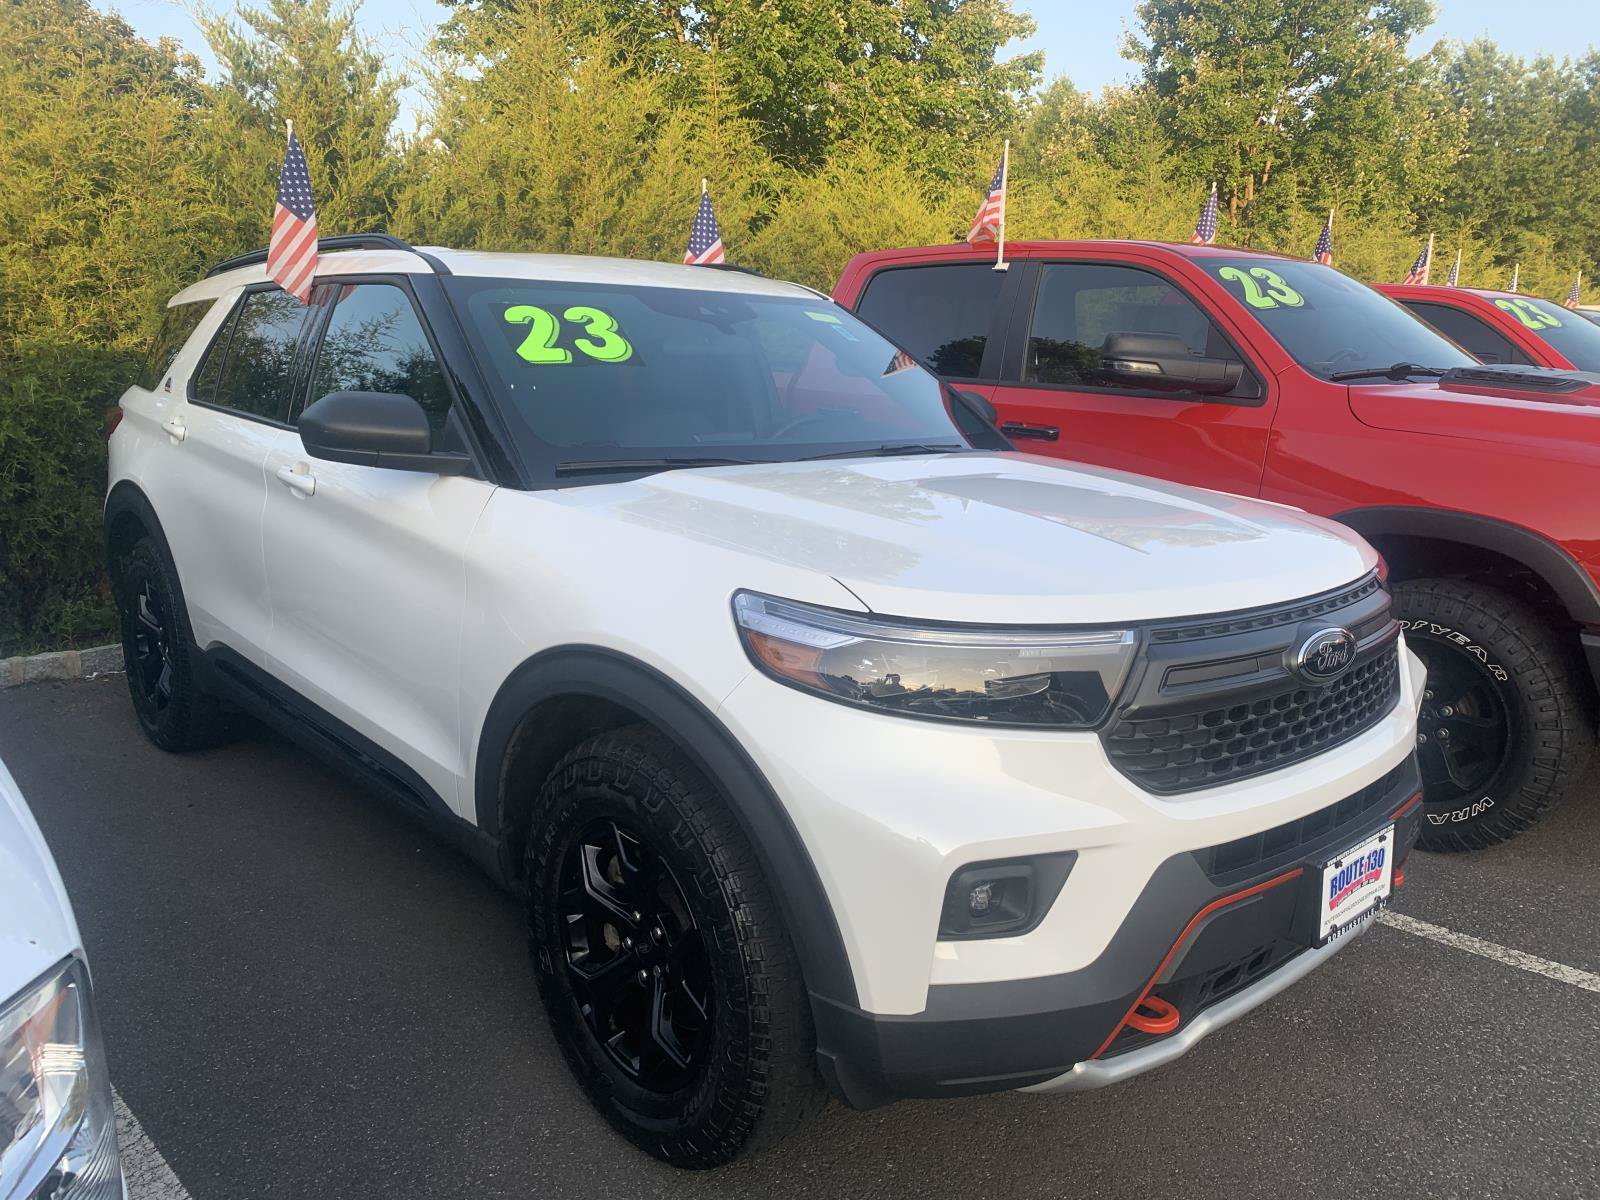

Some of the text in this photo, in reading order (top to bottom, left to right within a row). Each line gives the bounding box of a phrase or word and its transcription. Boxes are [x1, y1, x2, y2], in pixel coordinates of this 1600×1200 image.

[1218, 266, 1305, 309] 23
[1494, 298, 1562, 330] 23
[503, 304, 633, 364] 23
[1317, 640, 1350, 672] Ford
[1427, 796, 1494, 825] WRA
[1330, 855, 1365, 900] ROUTE
[1367, 847, 1385, 872] 130
